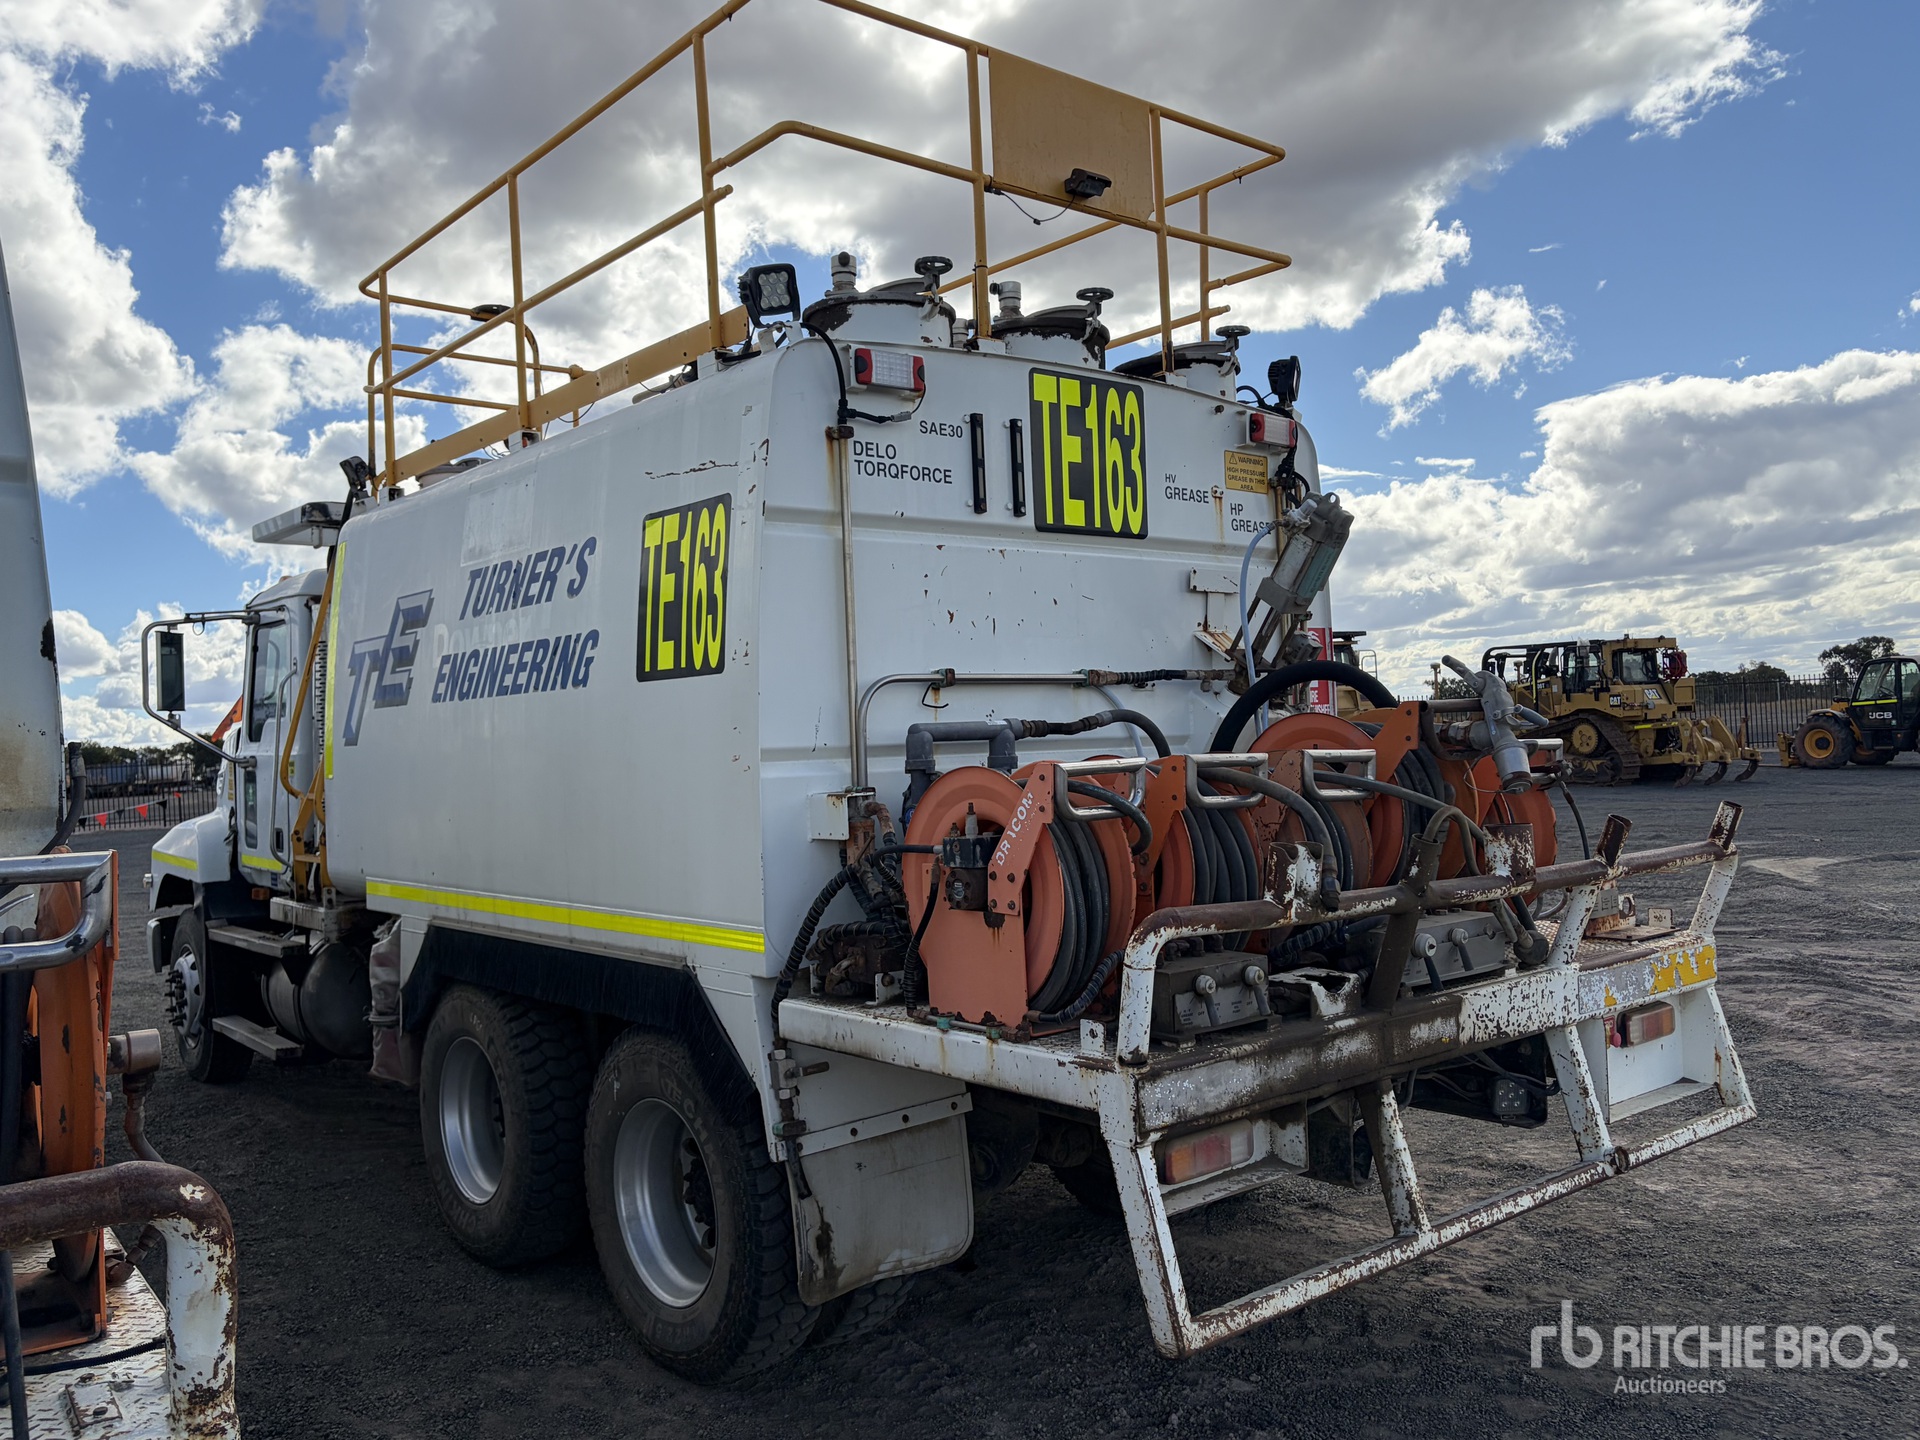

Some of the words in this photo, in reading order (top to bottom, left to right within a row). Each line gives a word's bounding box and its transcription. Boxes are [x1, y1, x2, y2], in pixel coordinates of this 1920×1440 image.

[919, 420, 963, 438] SAE30
[853, 440, 897, 460] DELO
[1033, 373, 1143, 534] TE163
[1238, 456, 1264, 467] WARNING
[854, 459, 953, 485] TORQFORCE
[1164, 473, 1177, 484] HV
[1226, 466, 1239, 474] HIGH
[1240, 468, 1266, 478] PRESSURE
[1164, 486, 1210, 504] GREASE
[1230, 503, 1244, 516] HP
[459, 536, 598, 621] TURNER'S
[644, 503, 729, 673] TE163
[431, 629, 600, 704] ENGINEERING
[1610, 696, 1621, 706] CAT
[1644, 688, 1660, 699] CAT
[1869, 711, 1893, 719] JCB
